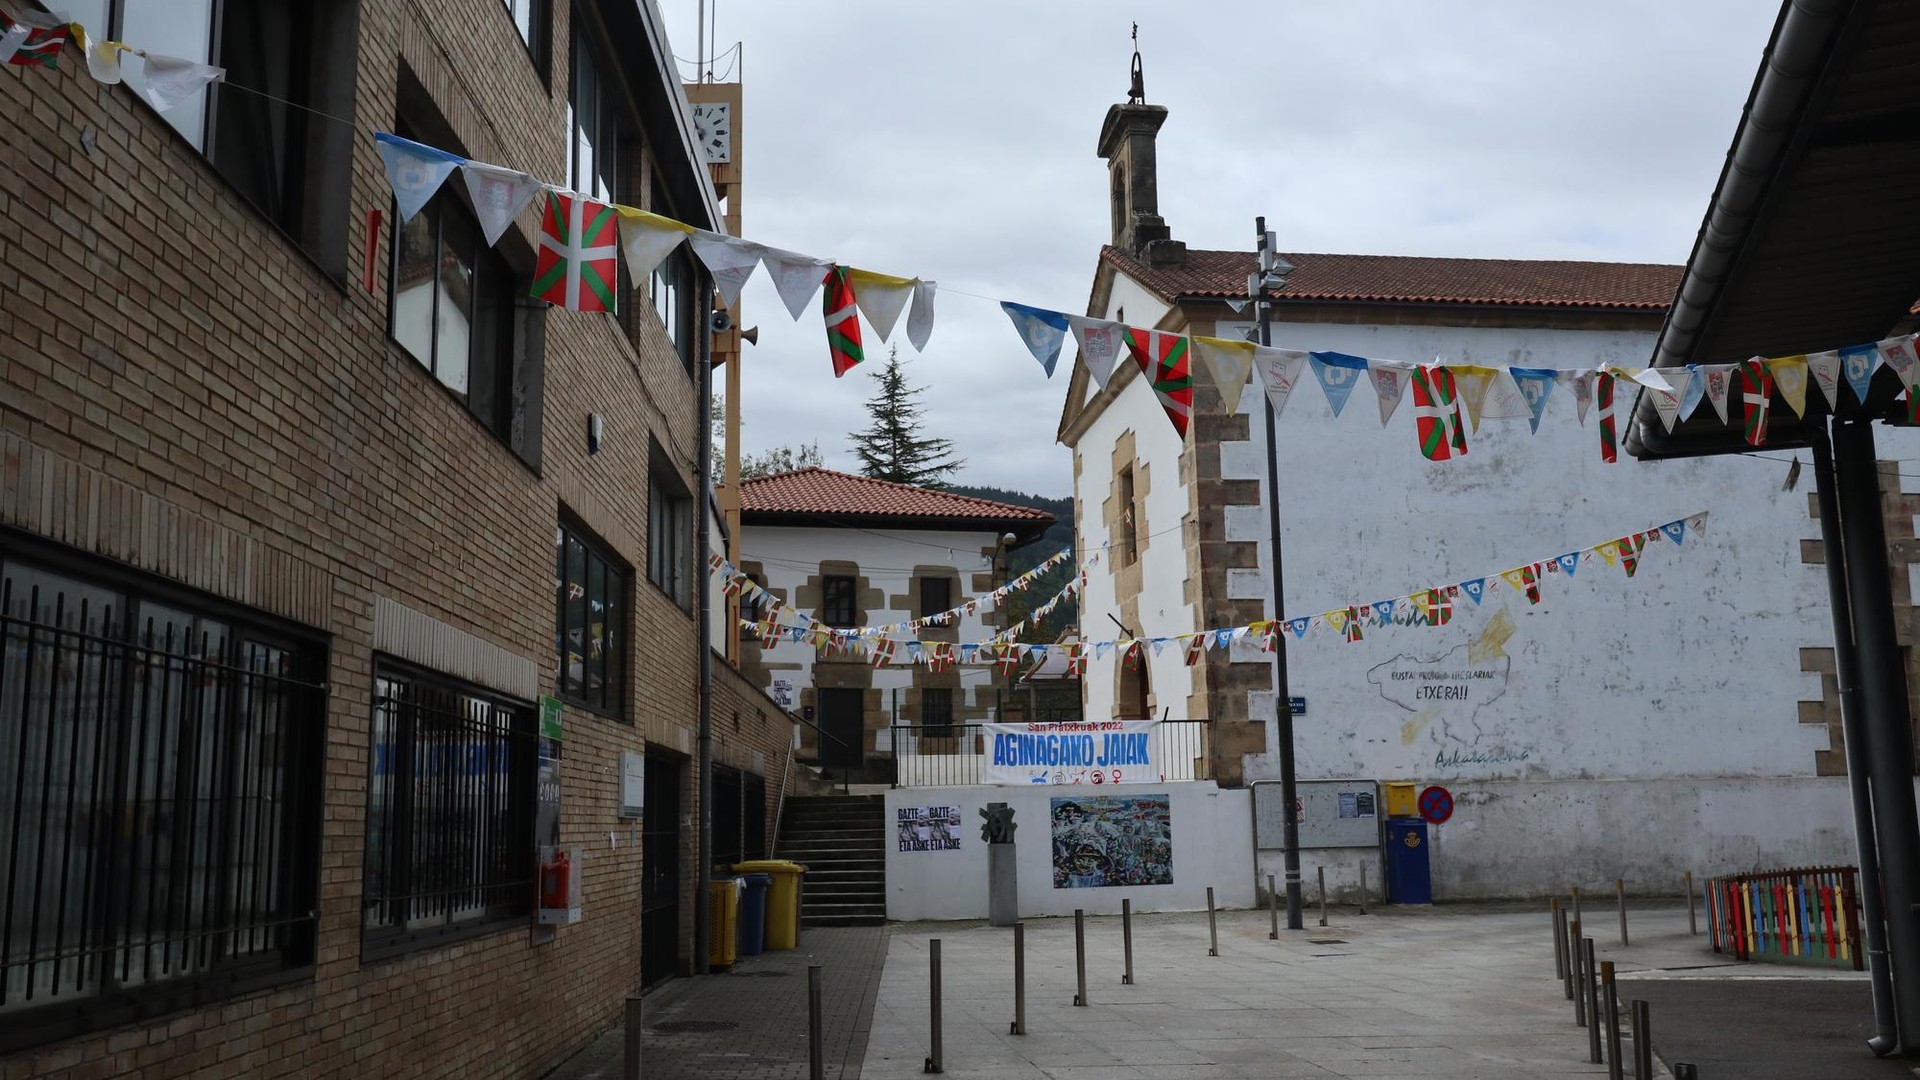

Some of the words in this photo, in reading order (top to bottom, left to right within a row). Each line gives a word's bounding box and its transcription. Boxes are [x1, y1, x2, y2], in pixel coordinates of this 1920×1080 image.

[1416, 685, 1468, 700] ETXERA!!
[1028, 723, 1046, 732] San
[1101, 721, 1124, 731] 2022
[994, 733, 1094, 767] AGINAGAKO
[1096, 732, 1149, 767] JAIAK
